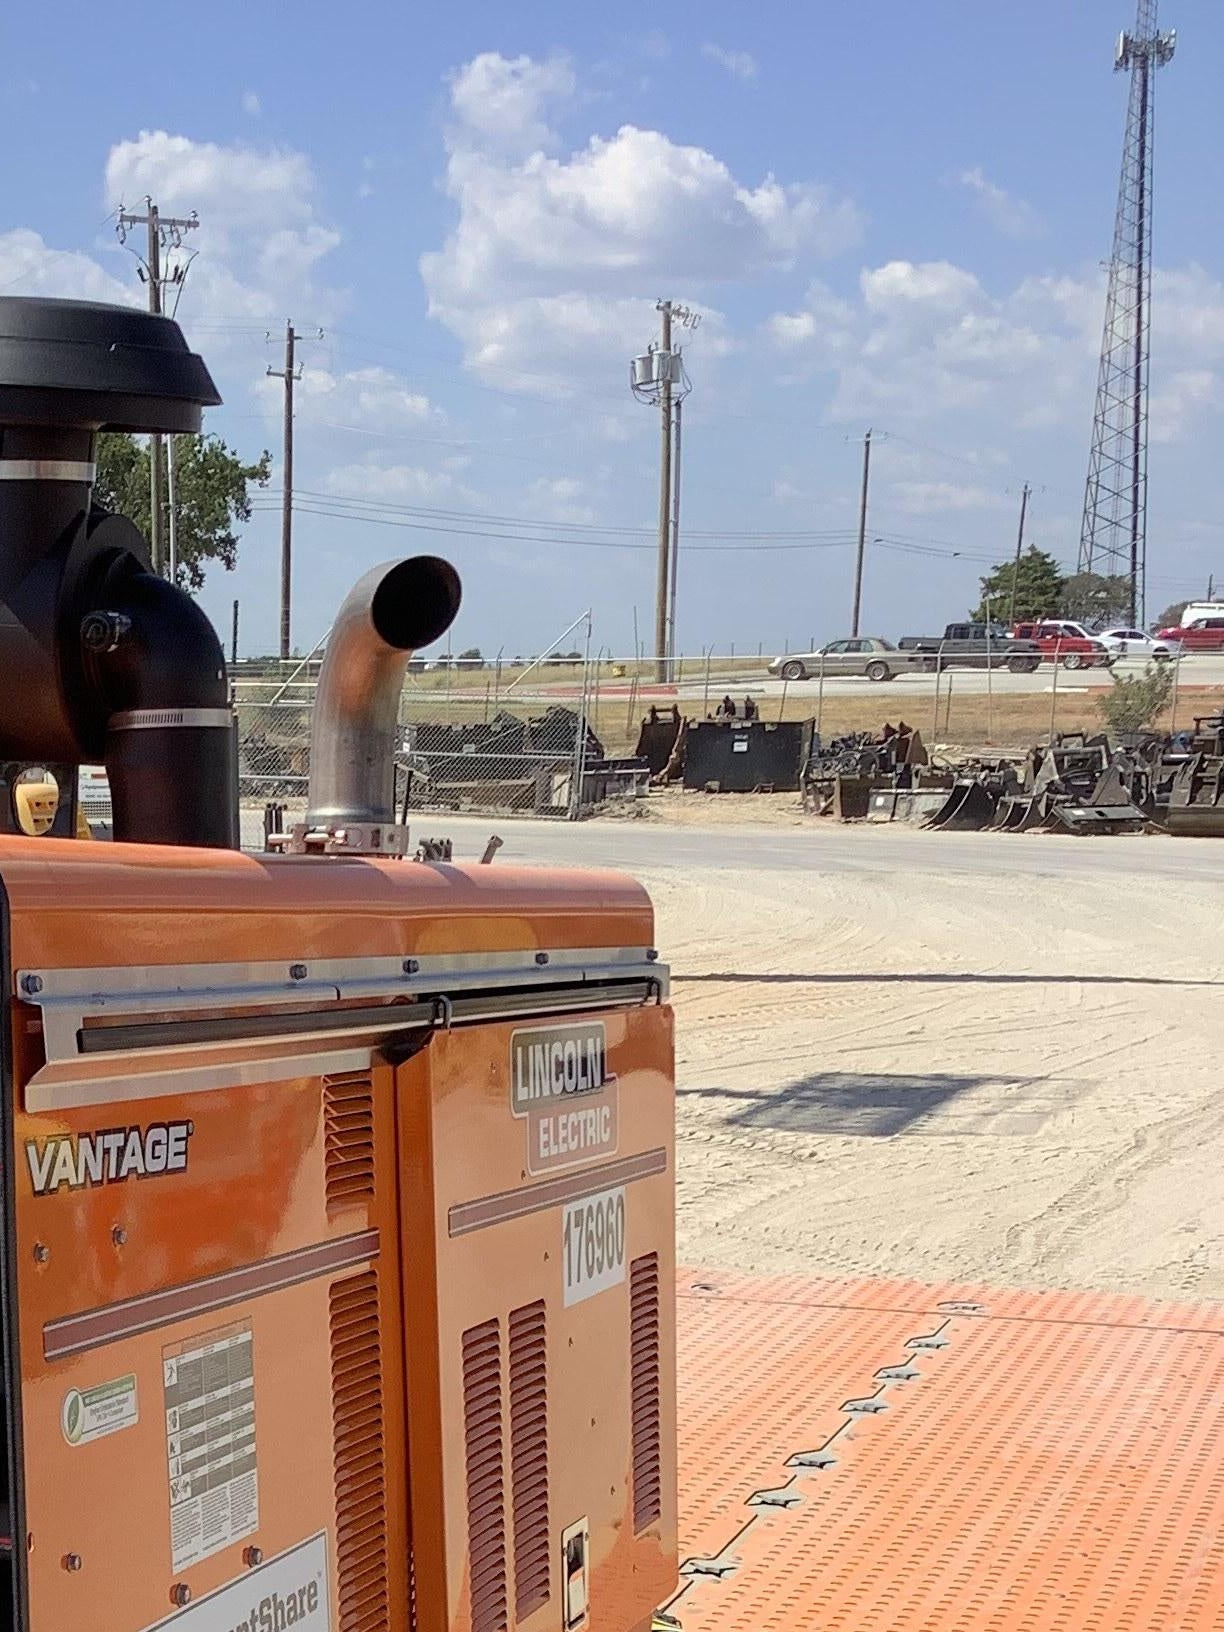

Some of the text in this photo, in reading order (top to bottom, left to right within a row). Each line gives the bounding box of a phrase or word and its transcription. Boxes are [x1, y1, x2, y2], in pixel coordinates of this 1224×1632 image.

[516, 1037, 602, 1101] LINCOLN
[26, 1124, 189, 1193] VANTAGE
[538, 1105, 612, 1159] ELECTRIC
[564, 1193, 625, 1288] 176960
